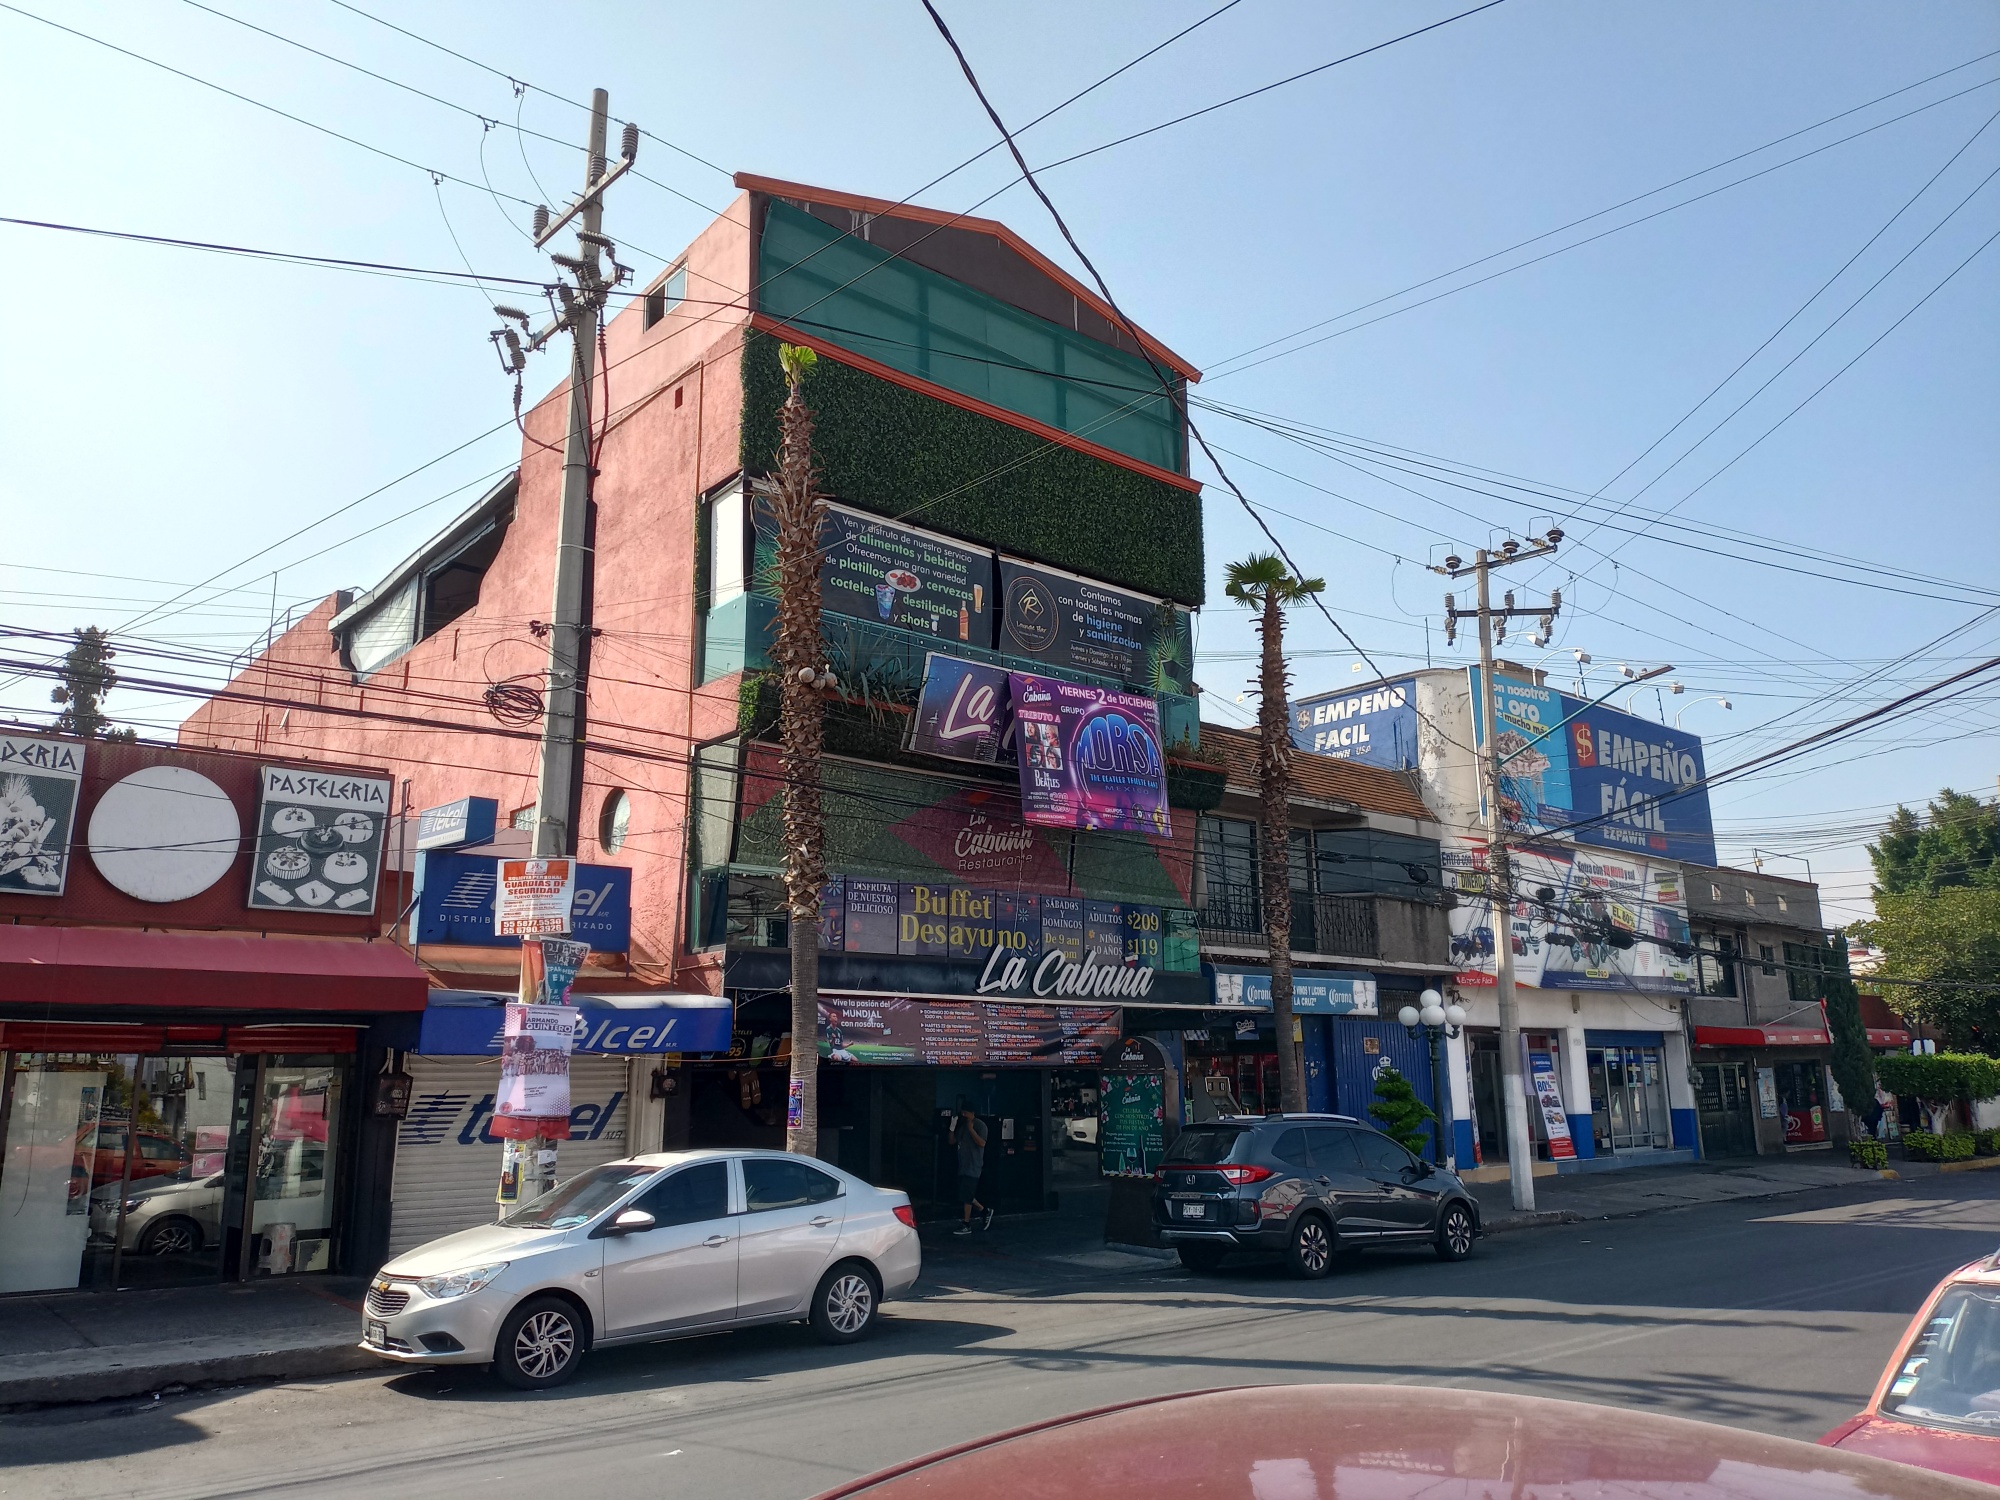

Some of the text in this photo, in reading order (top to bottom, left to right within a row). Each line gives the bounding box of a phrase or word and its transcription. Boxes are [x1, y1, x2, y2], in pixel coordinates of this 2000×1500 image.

[842, 515, 972, 563] Ven y disfruta de nuestro servicio
[846, 531, 970, 575] de alimentos y bebidas.
[846, 543, 966, 586] Ofrecemos una gran variedad
[826, 554, 974, 600] de platillos cervezas
[830, 577, 958, 618] cocteles destilados
[1080, 587, 1122, 607] Contamos
[1058, 594, 1143, 625] con todas las normas
[893, 612, 930, 629] y shots
[1072, 612, 1122, 632] de higiene
[1079, 628, 1142, 650] y sanitización
[1023, 690, 1052, 702] Cabaña
[1058, 685, 1096, 700] VIERNES
[1096, 688, 1108, 704] 2
[1107, 693, 1118, 702] de
[1493, 684, 1550, 703] on nosotros
[939, 672, 996, 740] La
[1018, 709, 1061, 723] TRIBUTO A
[1060, 705, 1084, 716] GRUPO
[1313, 686, 1406, 726] EMPEÑO
[1494, 696, 1540, 722] u oro
[1504, 712, 1532, 732] mucho
[1076, 714, 1161, 780] MORSA
[1314, 724, 1370, 752] FACIL
[1598, 730, 1697, 786] EMPEÑO
[269, 773, 385, 804] PASTELERIA
[1034, 770, 1060, 790] BEATLES
[1601, 776, 1665, 833] FÁCIL
[432, 802, 466, 832] telcel
[955, 823, 1033, 858] Cabaña
[1604, 827, 1646, 846] EZPAWN
[958, 854, 1032, 870] Restaurante
[505, 880, 551, 888] GUARDIAS
[853, 882, 892, 893] DISFRUTA
[1462, 874, 1483, 889] DINERO
[848, 892, 896, 904] DE NUESTRO
[914, 886, 992, 920] Buffet
[1046, 898, 1079, 910] SÁBADOS
[851, 903, 894, 915] DELICIOSO
[1060, 910, 1065, 918] Y
[1088, 912, 1122, 924] ADULTOS
[440, 914, 490, 924] DISTRIB
[571, 922, 612, 931] RIZADO
[1042, 918, 1082, 930] DOMINGOS
[1127, 911, 1159, 932] $209
[900, 914, 1026, 955] Desayuno
[1046, 933, 1080, 946] De 9 am
[1100, 932, 1122, 944] NIÑOS
[1103, 945, 1123, 956] AÑOS
[1128, 938, 1158, 956] $119
[976, 944, 1027, 994] La
[1296, 986, 1308, 995] VINOS
[1311, 987, 1326, 996] LICORES
[1329, 988, 1353, 1008] Corona
[856, 1000, 879, 1008] pasión
[526, 1023, 572, 1032] QUINTERO
[574, 1018, 678, 1049] elcel
